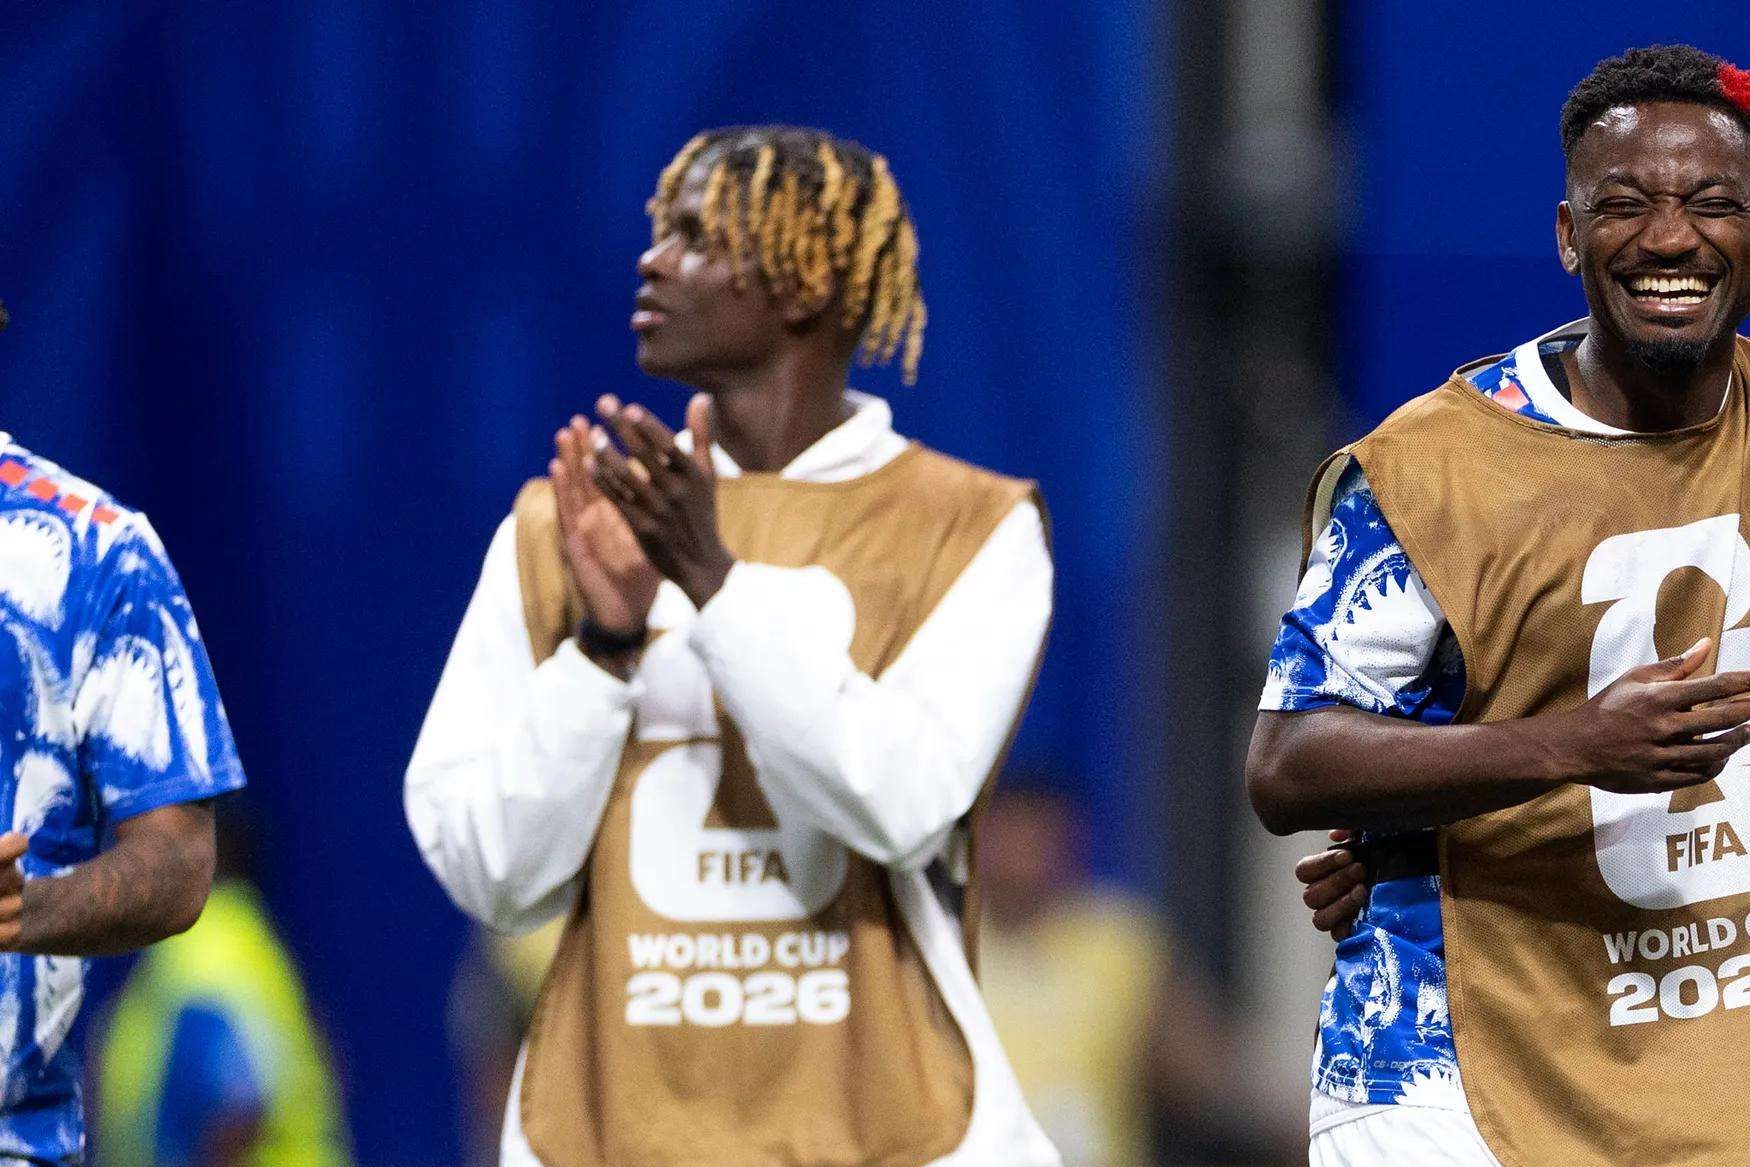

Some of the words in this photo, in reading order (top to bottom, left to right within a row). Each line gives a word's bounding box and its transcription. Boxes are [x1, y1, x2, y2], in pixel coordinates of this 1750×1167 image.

[696, 849, 791, 886] FIFA
[1666, 821, 1748, 873] FIFA
[629, 933, 771, 969] WORLD
[774, 931, 850, 966] CUP
[1602, 916, 1738, 964] WORLD
[624, 969, 852, 1027] 2026
